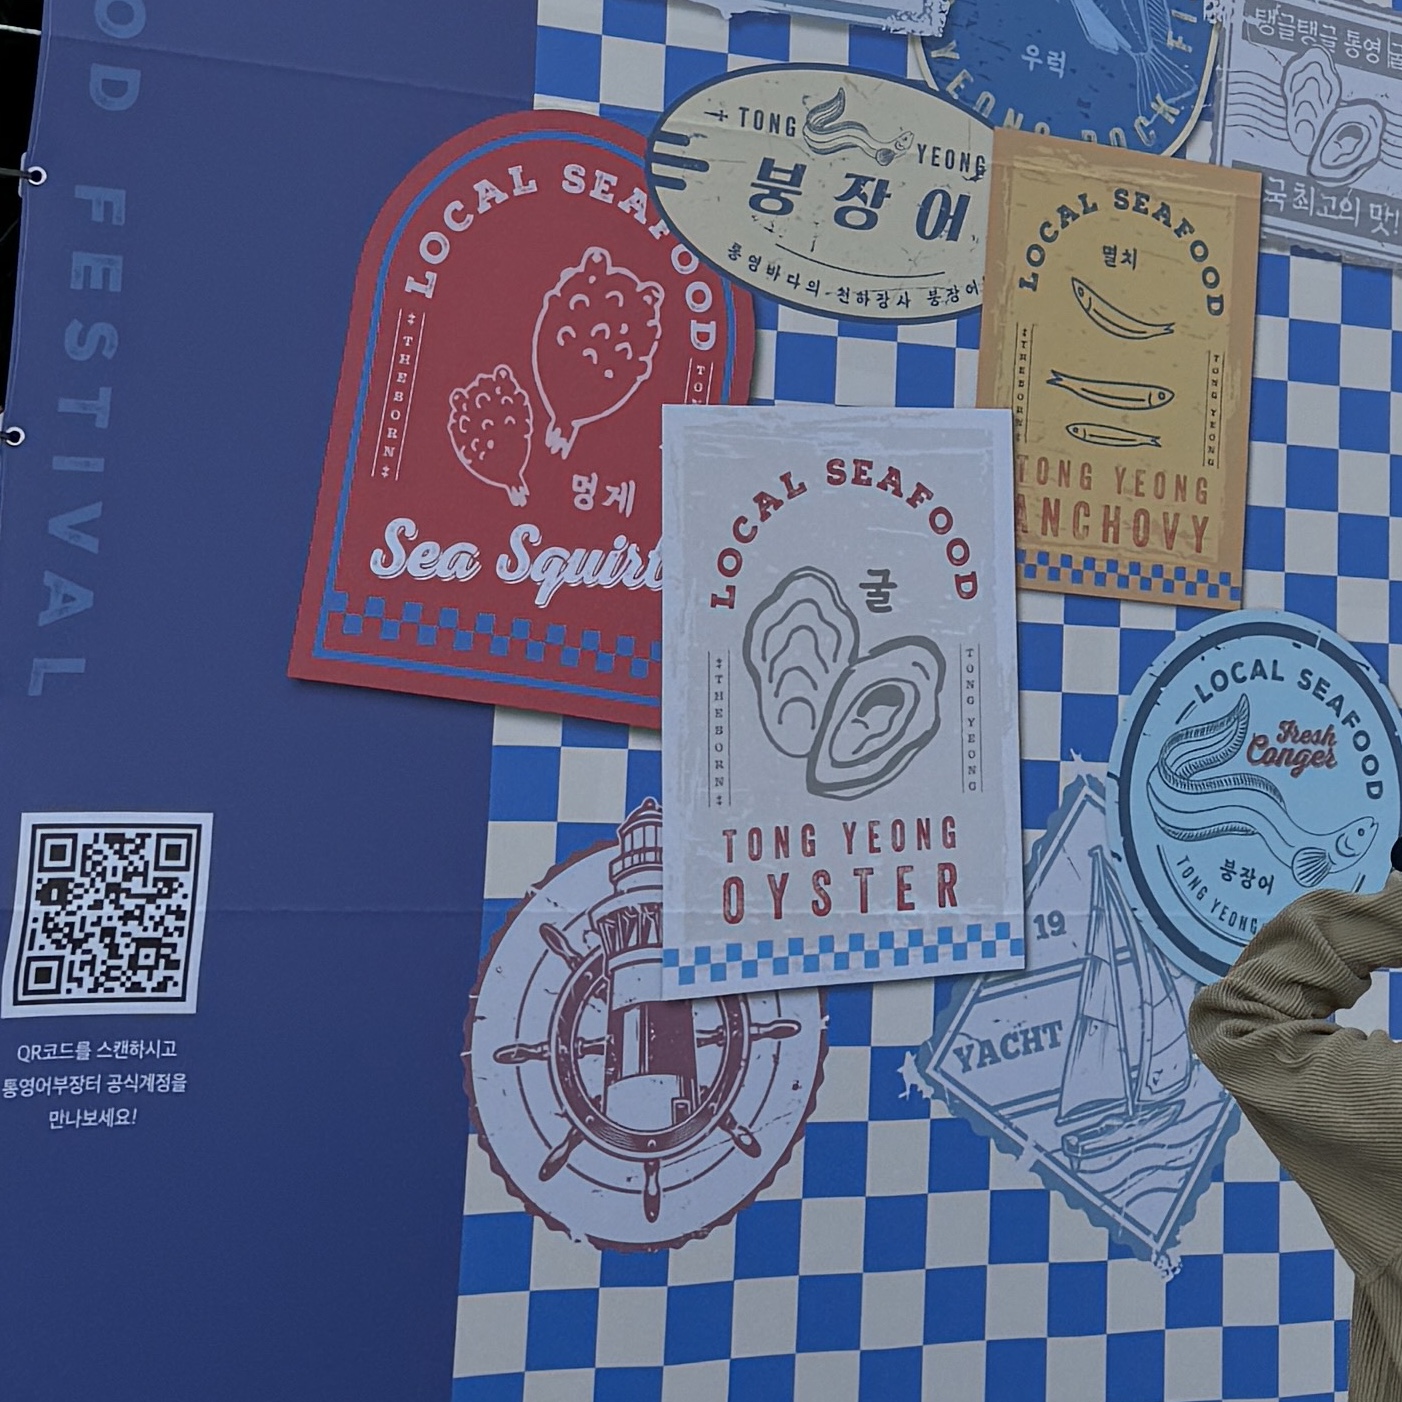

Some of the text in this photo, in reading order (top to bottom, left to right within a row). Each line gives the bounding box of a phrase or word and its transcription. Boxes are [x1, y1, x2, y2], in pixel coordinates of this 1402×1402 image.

[1020, 43, 1067, 79] 우럭
[1343, 29, 1382, 64] 통영
[738, 106, 987, 176] TONG YEONG
[747, 157, 972, 243] 붕장어
[404, 162, 717, 351] LOCAL SEAFOOD
[1018, 187, 1225, 318] LOCAL SEAFOOD
[1101, 244, 1138, 271] 멸치
[836, 285, 912, 309] 천하장사
[27, 184, 127, 698] FESTIVAL
[1015, 454, 1209, 505] TONG YEONG
[710, 457, 980, 610] LOCAL SEAFOOD
[1015, 492, 1210, 554] ANCHOVY
[370, 517, 663, 608] Sea Squirt
[858, 568, 899, 614] 굴
[965, 647, 977, 792] TONG YEONG
[1194, 658, 1384, 801] LOCAL SEAFOOD
[1275, 719, 1338, 747] Fresh
[1246, 733, 1338, 778] Conger
[722, 815, 958, 864] TONG YEONG
[722, 862, 958, 925] OYSTER
[1176, 854, 1258, 935] TONG YEONG
[1219, 858, 1275, 896] 붕장어
[1032, 909, 1066, 941] 19
[16, 1038, 178, 1063] QR코드를 스캔하시고
[953, 1020, 1063, 1074] YACHT
[1, 1072, 188, 1099] 통영어부장터 공식계정을
[48, 1107, 138, 1130] 만나보세요!
